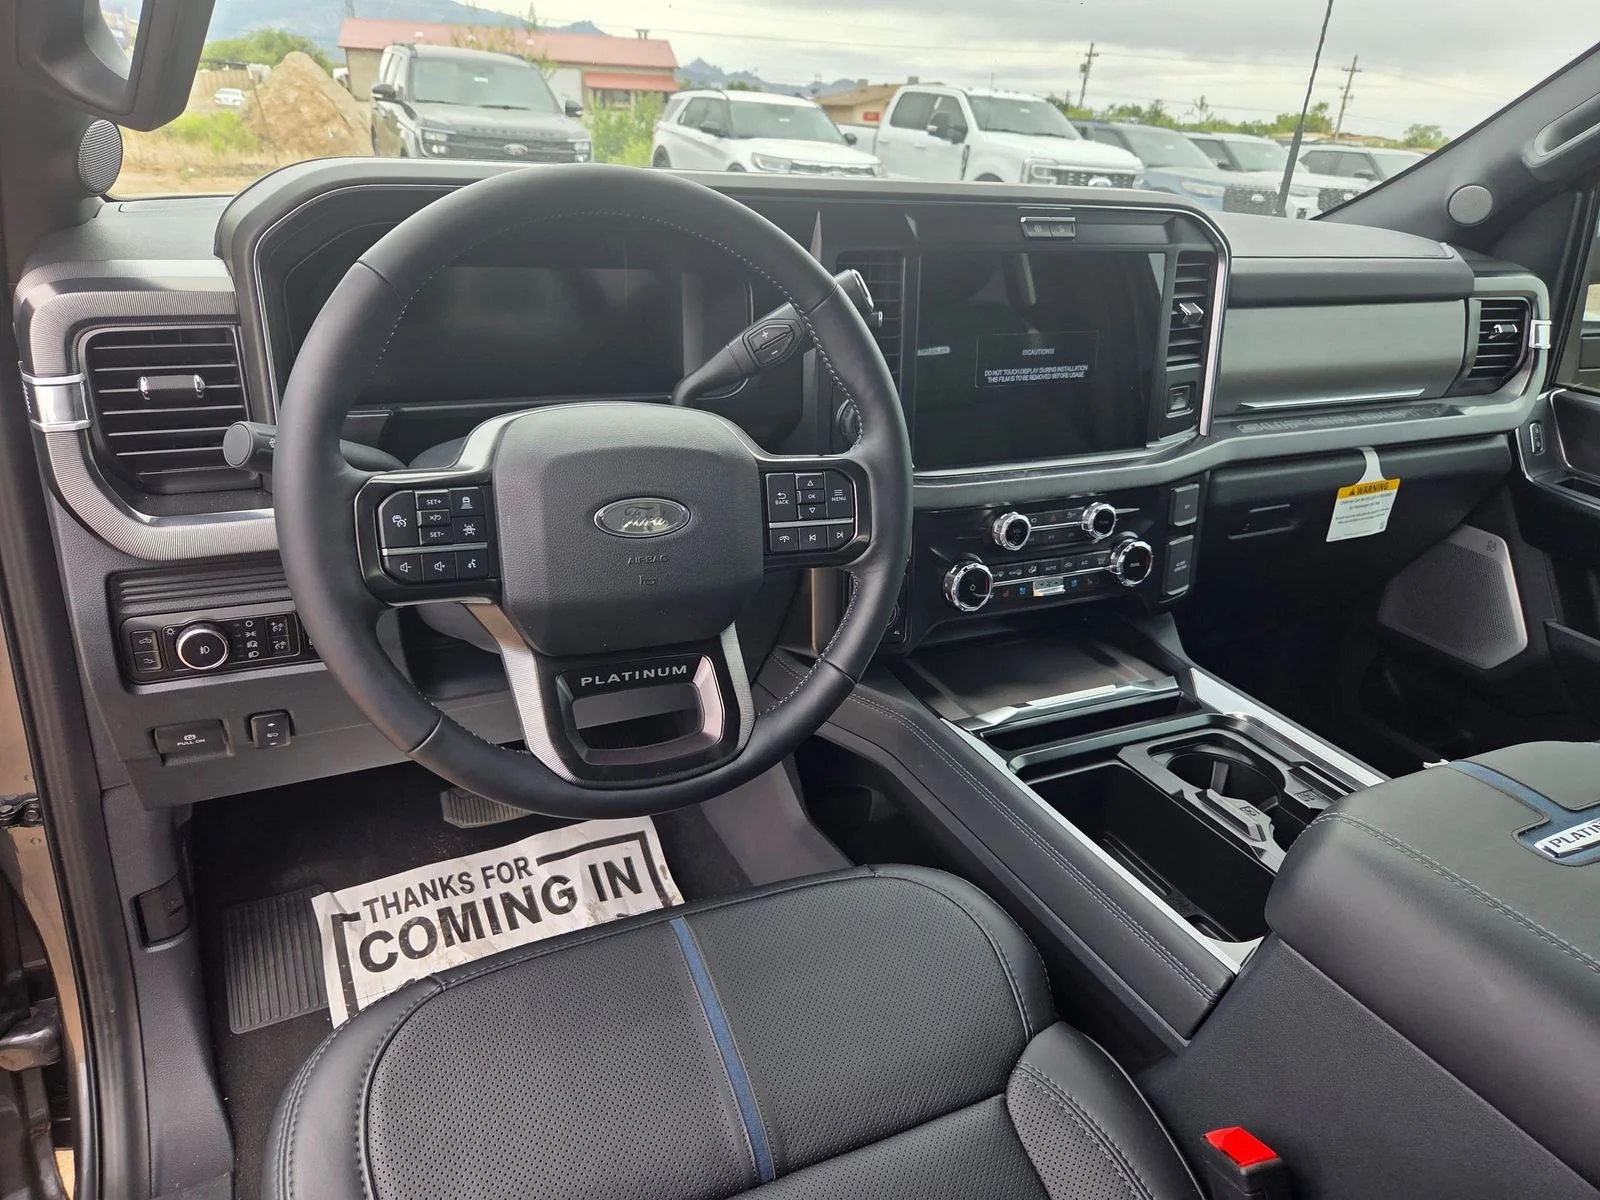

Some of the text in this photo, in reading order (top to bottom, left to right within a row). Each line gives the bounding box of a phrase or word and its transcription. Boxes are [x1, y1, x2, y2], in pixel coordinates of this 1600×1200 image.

[1003, 368, 1019, 376] TOUCH
[1019, 367, 1039, 375] DISPLAY
[1039, 366, 1056, 374] DURING
[1057, 364, 1088, 373] INSTALLATION
[1029, 373, 1051, 381] REMOVED
[1051, 372, 1069, 380] BEFORE
[1069, 371, 1085, 379] USAGE
[1356, 482, 1389, 497] WARNING
[627, 554, 668, 565] AIRBAG
[580, 664, 688, 687] PLATINUM
[362, 855, 534, 924] THANKS FOR
[358, 855, 644, 974] COMING IN
